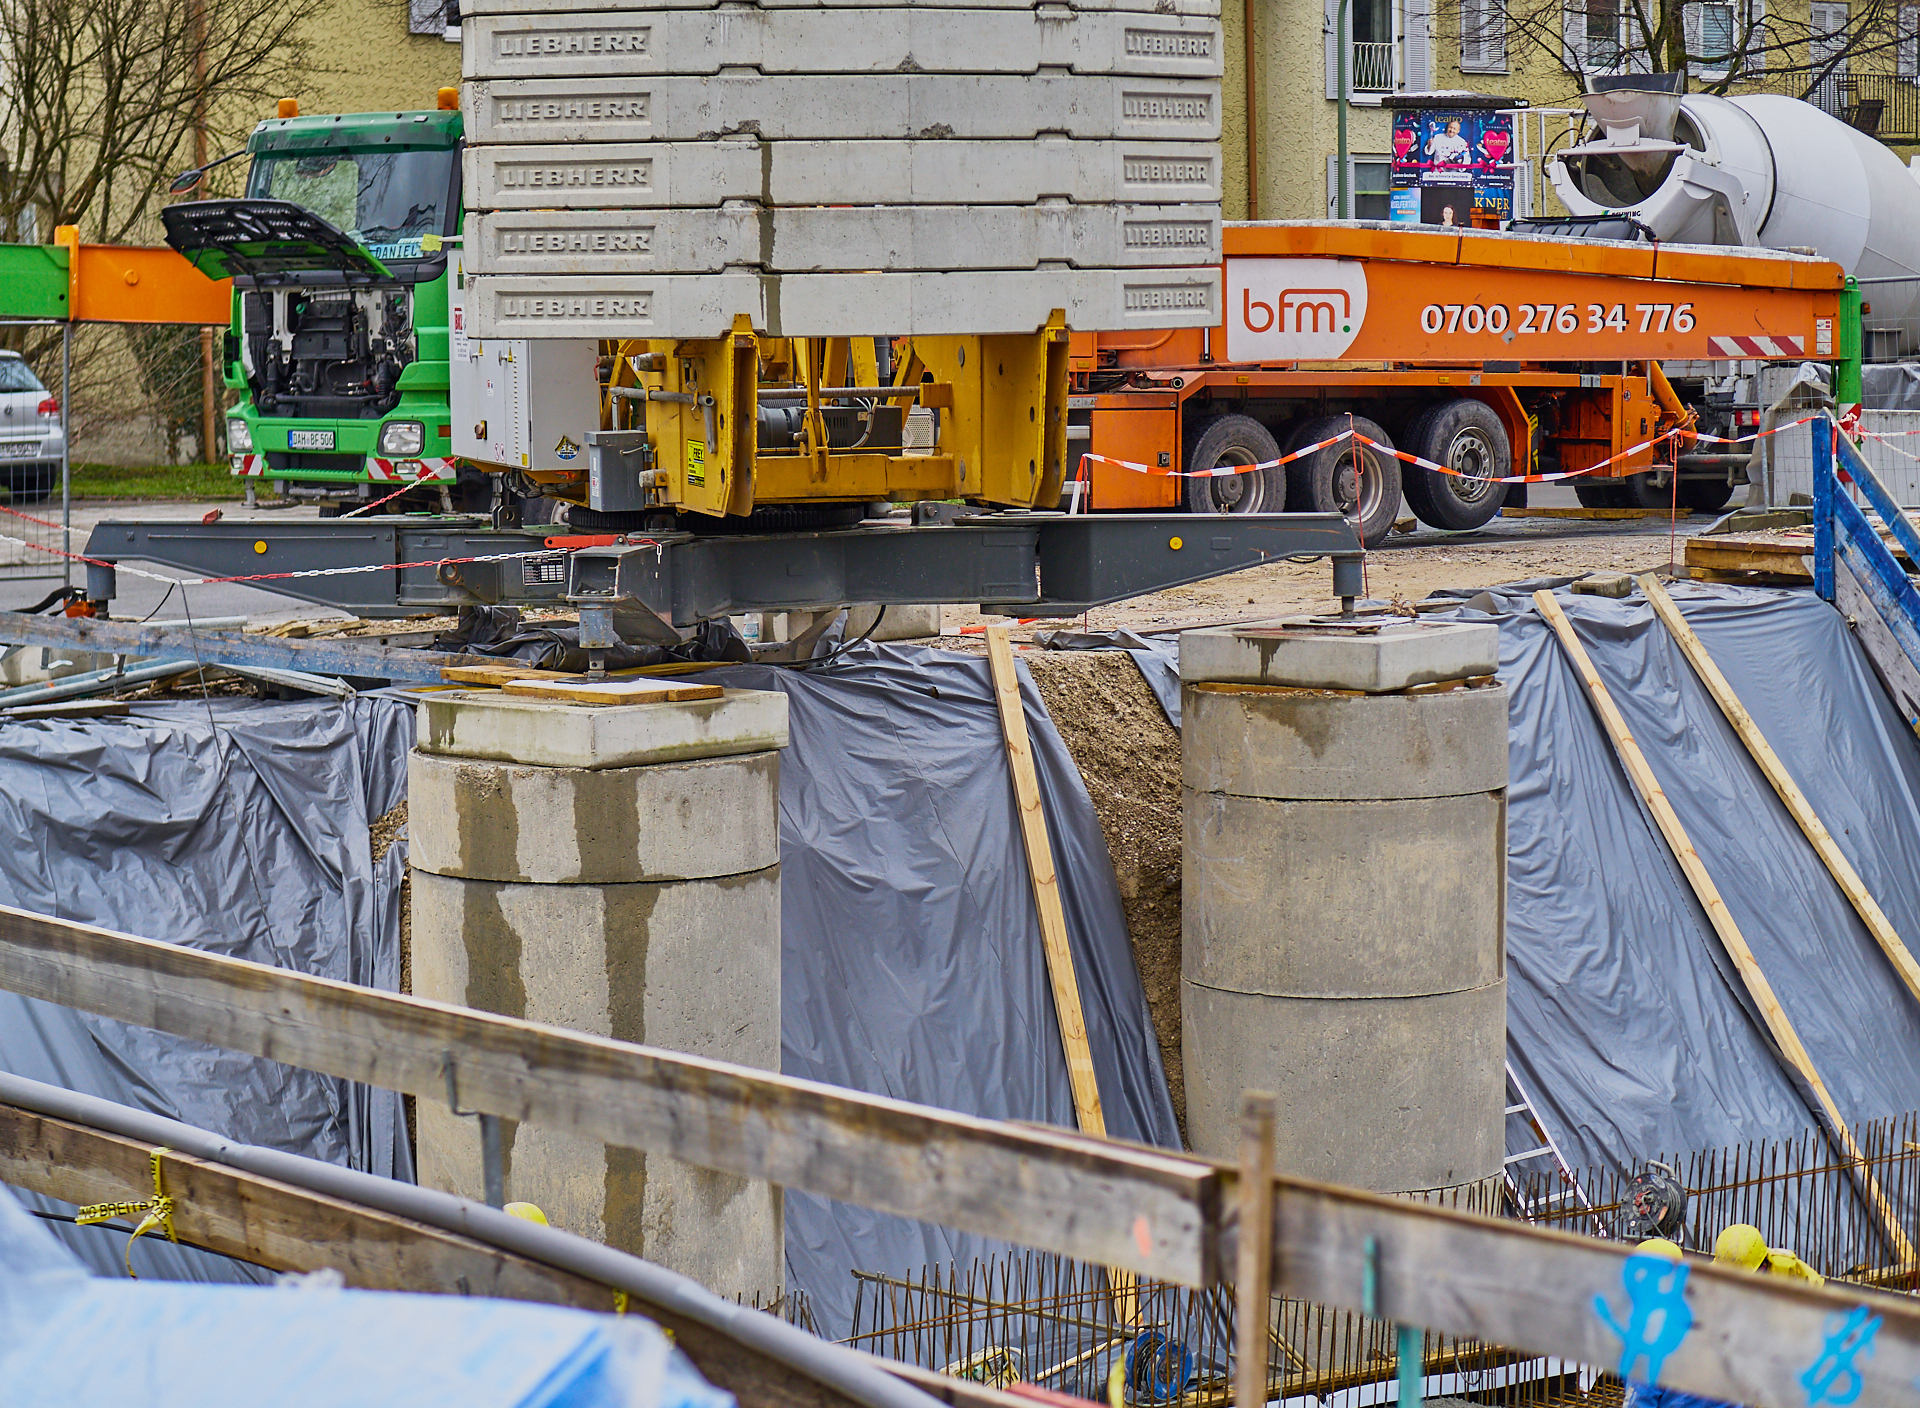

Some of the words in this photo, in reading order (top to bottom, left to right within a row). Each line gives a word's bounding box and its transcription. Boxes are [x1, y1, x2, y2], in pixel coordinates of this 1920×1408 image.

[500, 34, 647, 56] LIEBHERR
[1126, 35, 1210, 56] LIEBHERR
[500, 100, 647, 121] LIEBHERR
[1123, 100, 1207, 119] LIEBHERR
[1434, 115, 1463, 123] teatro
[1486, 138, 1507, 146] teatro
[502, 167, 648, 187] LIEBHERR
[1124, 163, 1207, 182] LIEBHERR
[503, 233, 651, 253] LIEBHERR
[1125, 227, 1207, 246] LIEBHERR
[375, 243, 418, 259] DANIEL
[504, 299, 649, 317] LIEBHERR
[1125, 290, 1207, 309] LIEBHERR
[1420, 303, 1510, 334] 0700
[1517, 303, 1580, 334] 276
[1587, 303, 1630, 334] 34
[1635, 303, 1697, 334] 776
[293, 432, 306, 445] DAH
